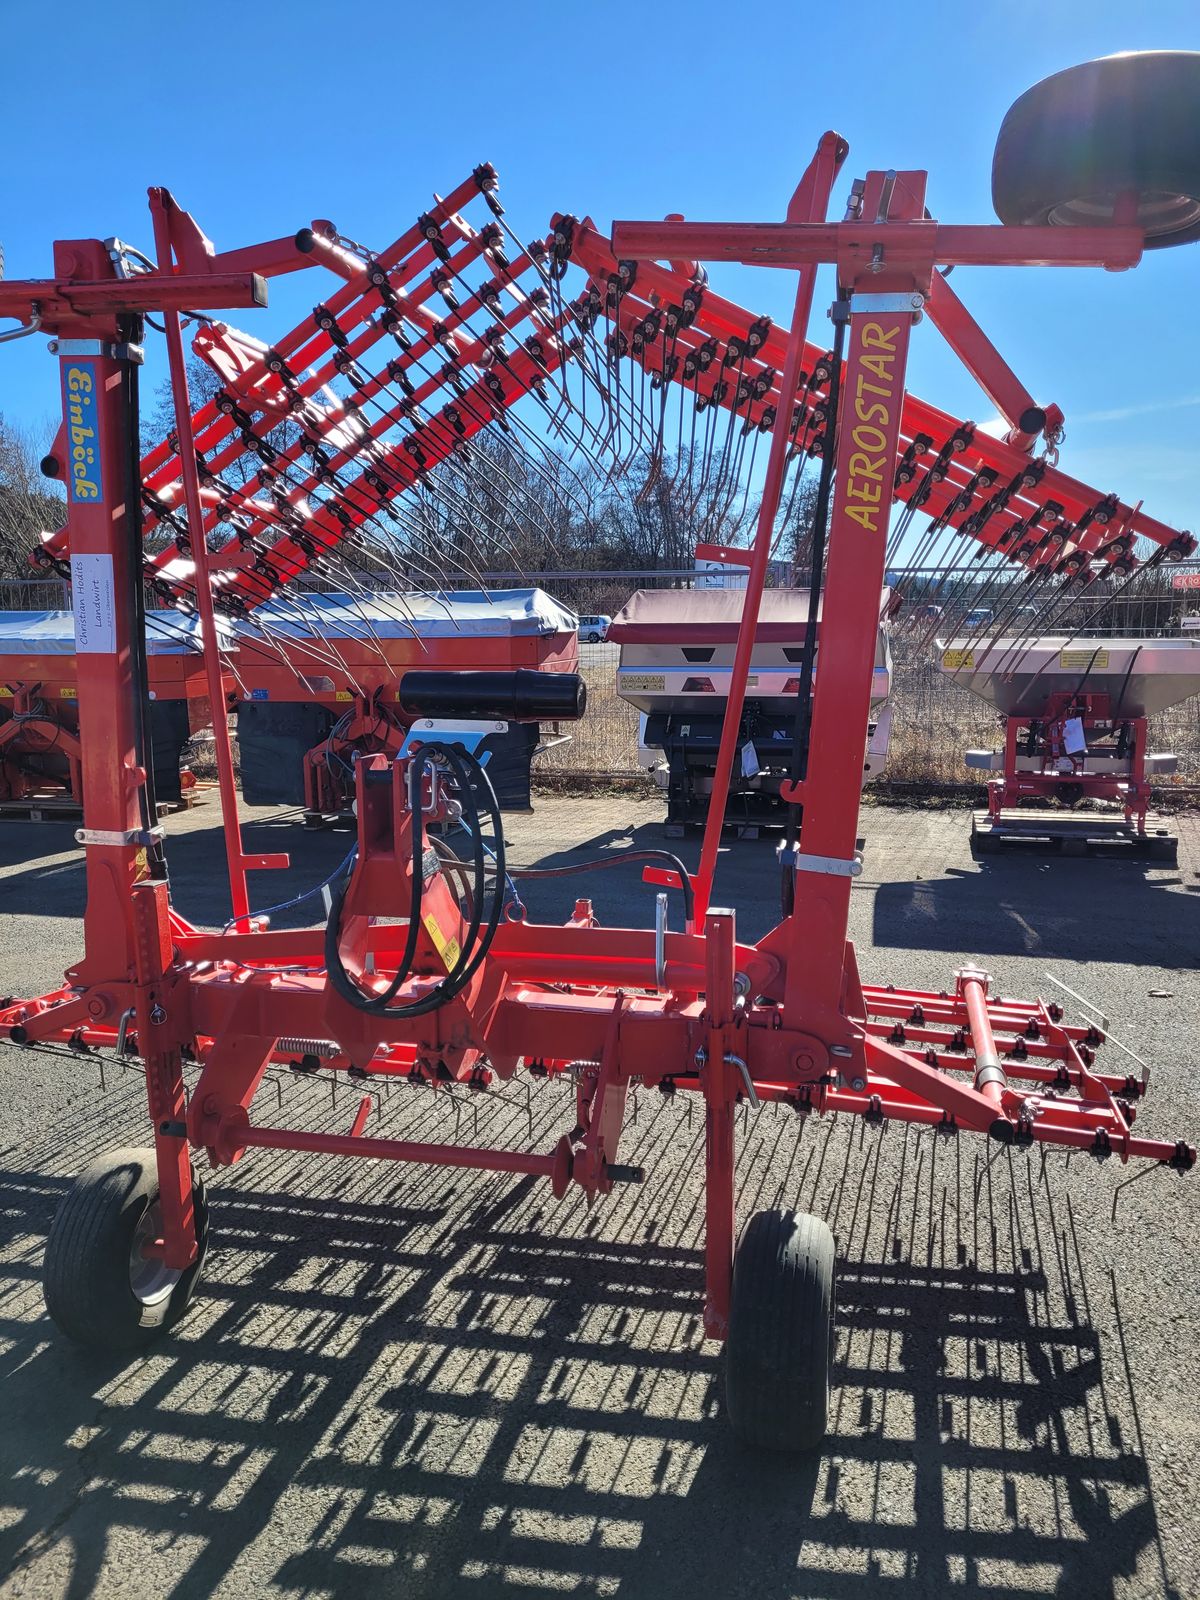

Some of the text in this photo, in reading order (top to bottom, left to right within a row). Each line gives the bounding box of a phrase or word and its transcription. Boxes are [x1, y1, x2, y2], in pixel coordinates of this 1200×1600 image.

[68, 367, 99, 498] Einböck
[844, 322, 901, 532] AEROSTAR
[75, 561, 89, 646] Christian Hodits
[92, 579, 102, 628] Landwirt
